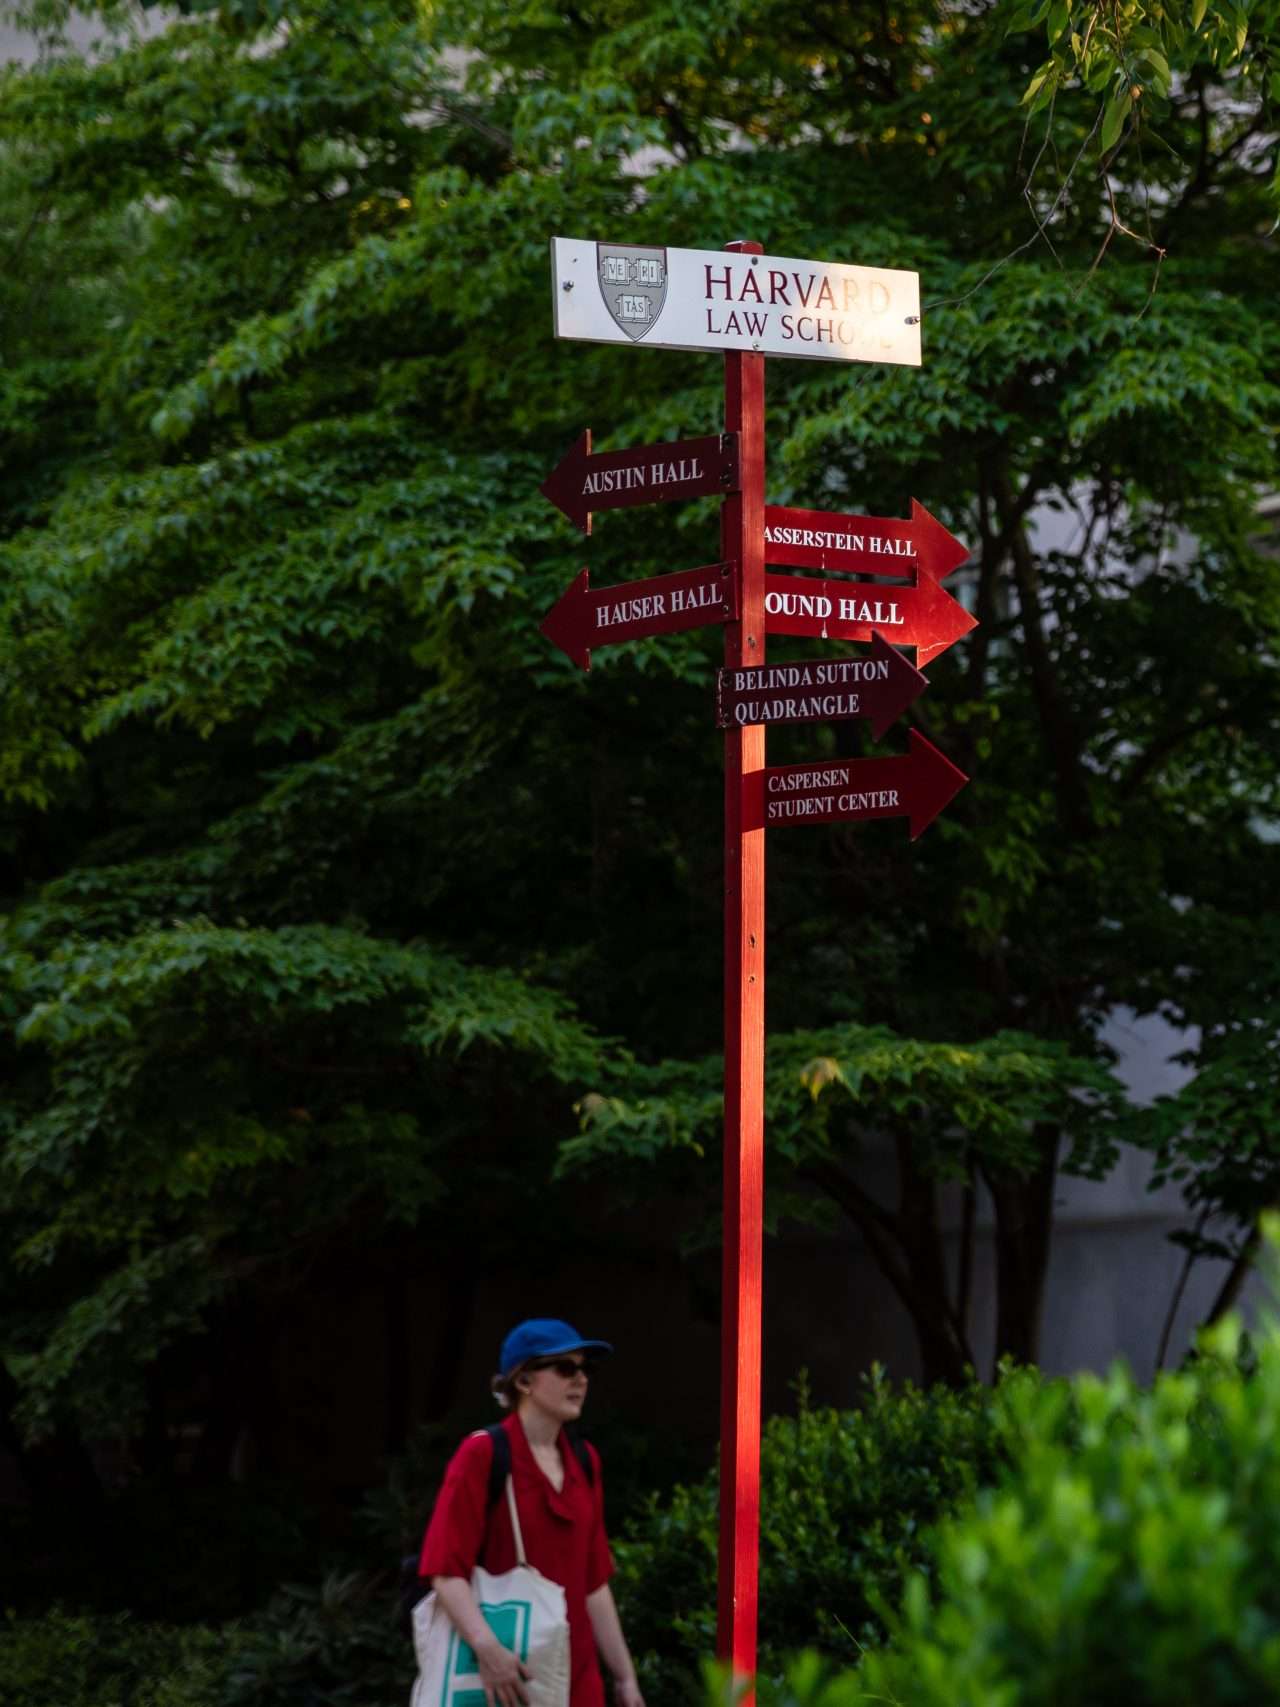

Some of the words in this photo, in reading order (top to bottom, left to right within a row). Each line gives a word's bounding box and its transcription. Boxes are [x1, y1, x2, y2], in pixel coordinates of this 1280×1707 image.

[704, 264, 891, 315] HARVARD
[625, 300, 644, 313] TAS
[706, 308, 769, 338] LAW
[781, 315, 893, 350] SCHO
[582, 465, 646, 496] AUSTIN
[651, 458, 704, 486] HALL
[764, 525, 865, 552] ASSERSTEIN
[869, 536, 918, 558] HALL
[596, 594, 666, 628] HAUSER
[671, 583, 724, 613] HALL
[765, 592, 832, 619] OUND
[839, 598, 905, 625] HALL
[735, 663, 813, 692] BELINDA
[816, 659, 889, 685] SUTTON
[735, 694, 860, 725] QUADRANGLE
[768, 768, 850, 793] CASPERSEN
[768, 796, 835, 819] STUDENT
[838, 789, 900, 812] CENTER
